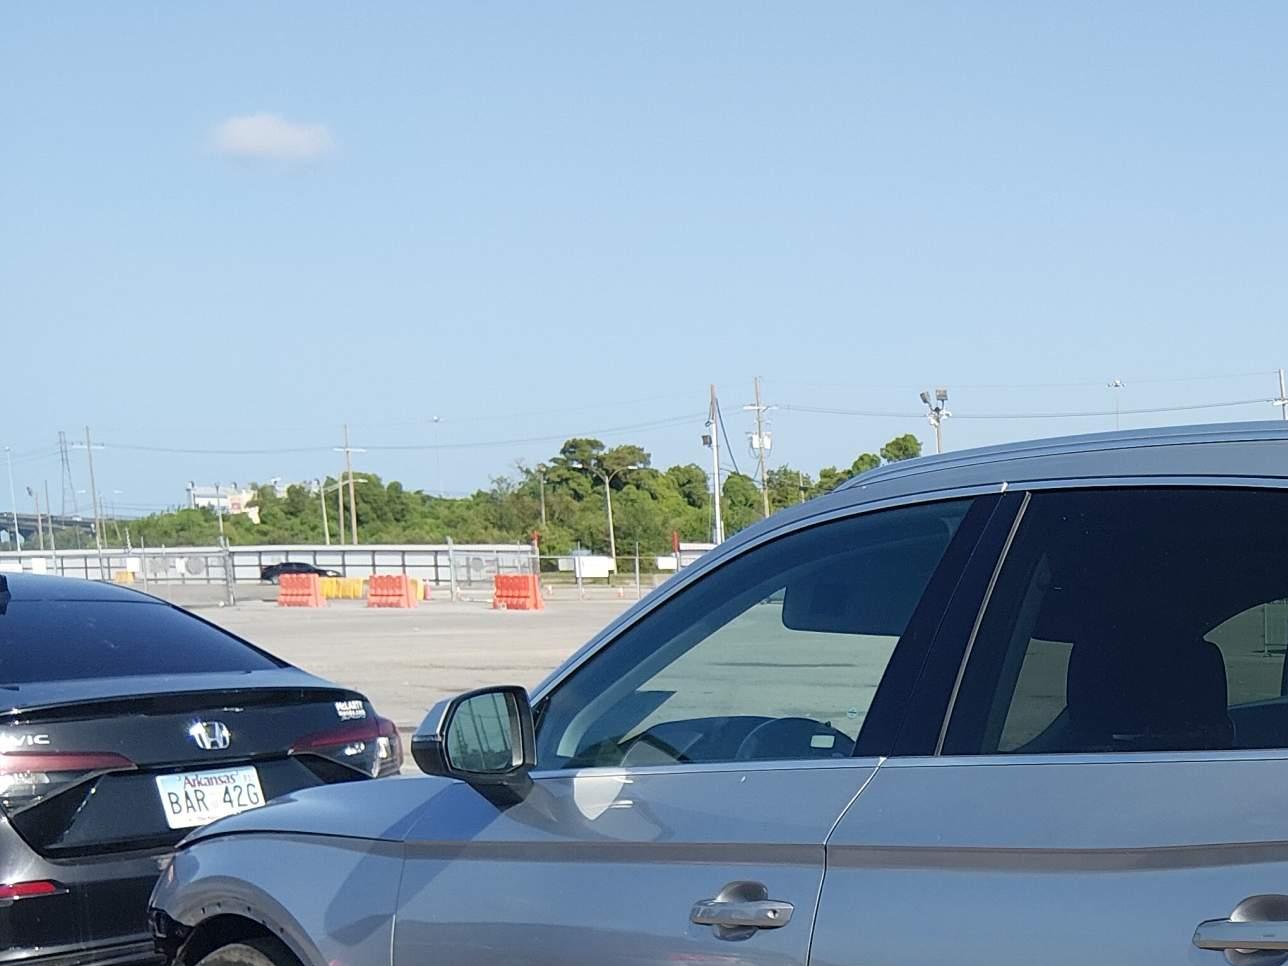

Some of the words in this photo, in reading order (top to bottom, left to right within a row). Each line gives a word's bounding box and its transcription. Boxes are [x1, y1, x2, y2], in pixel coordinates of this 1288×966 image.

[2, 735, 51, 746] VIC
[183, 773, 237, 788] Arkansas
[167, 789, 210, 815] BAR
[223, 783, 260, 808] 42G
